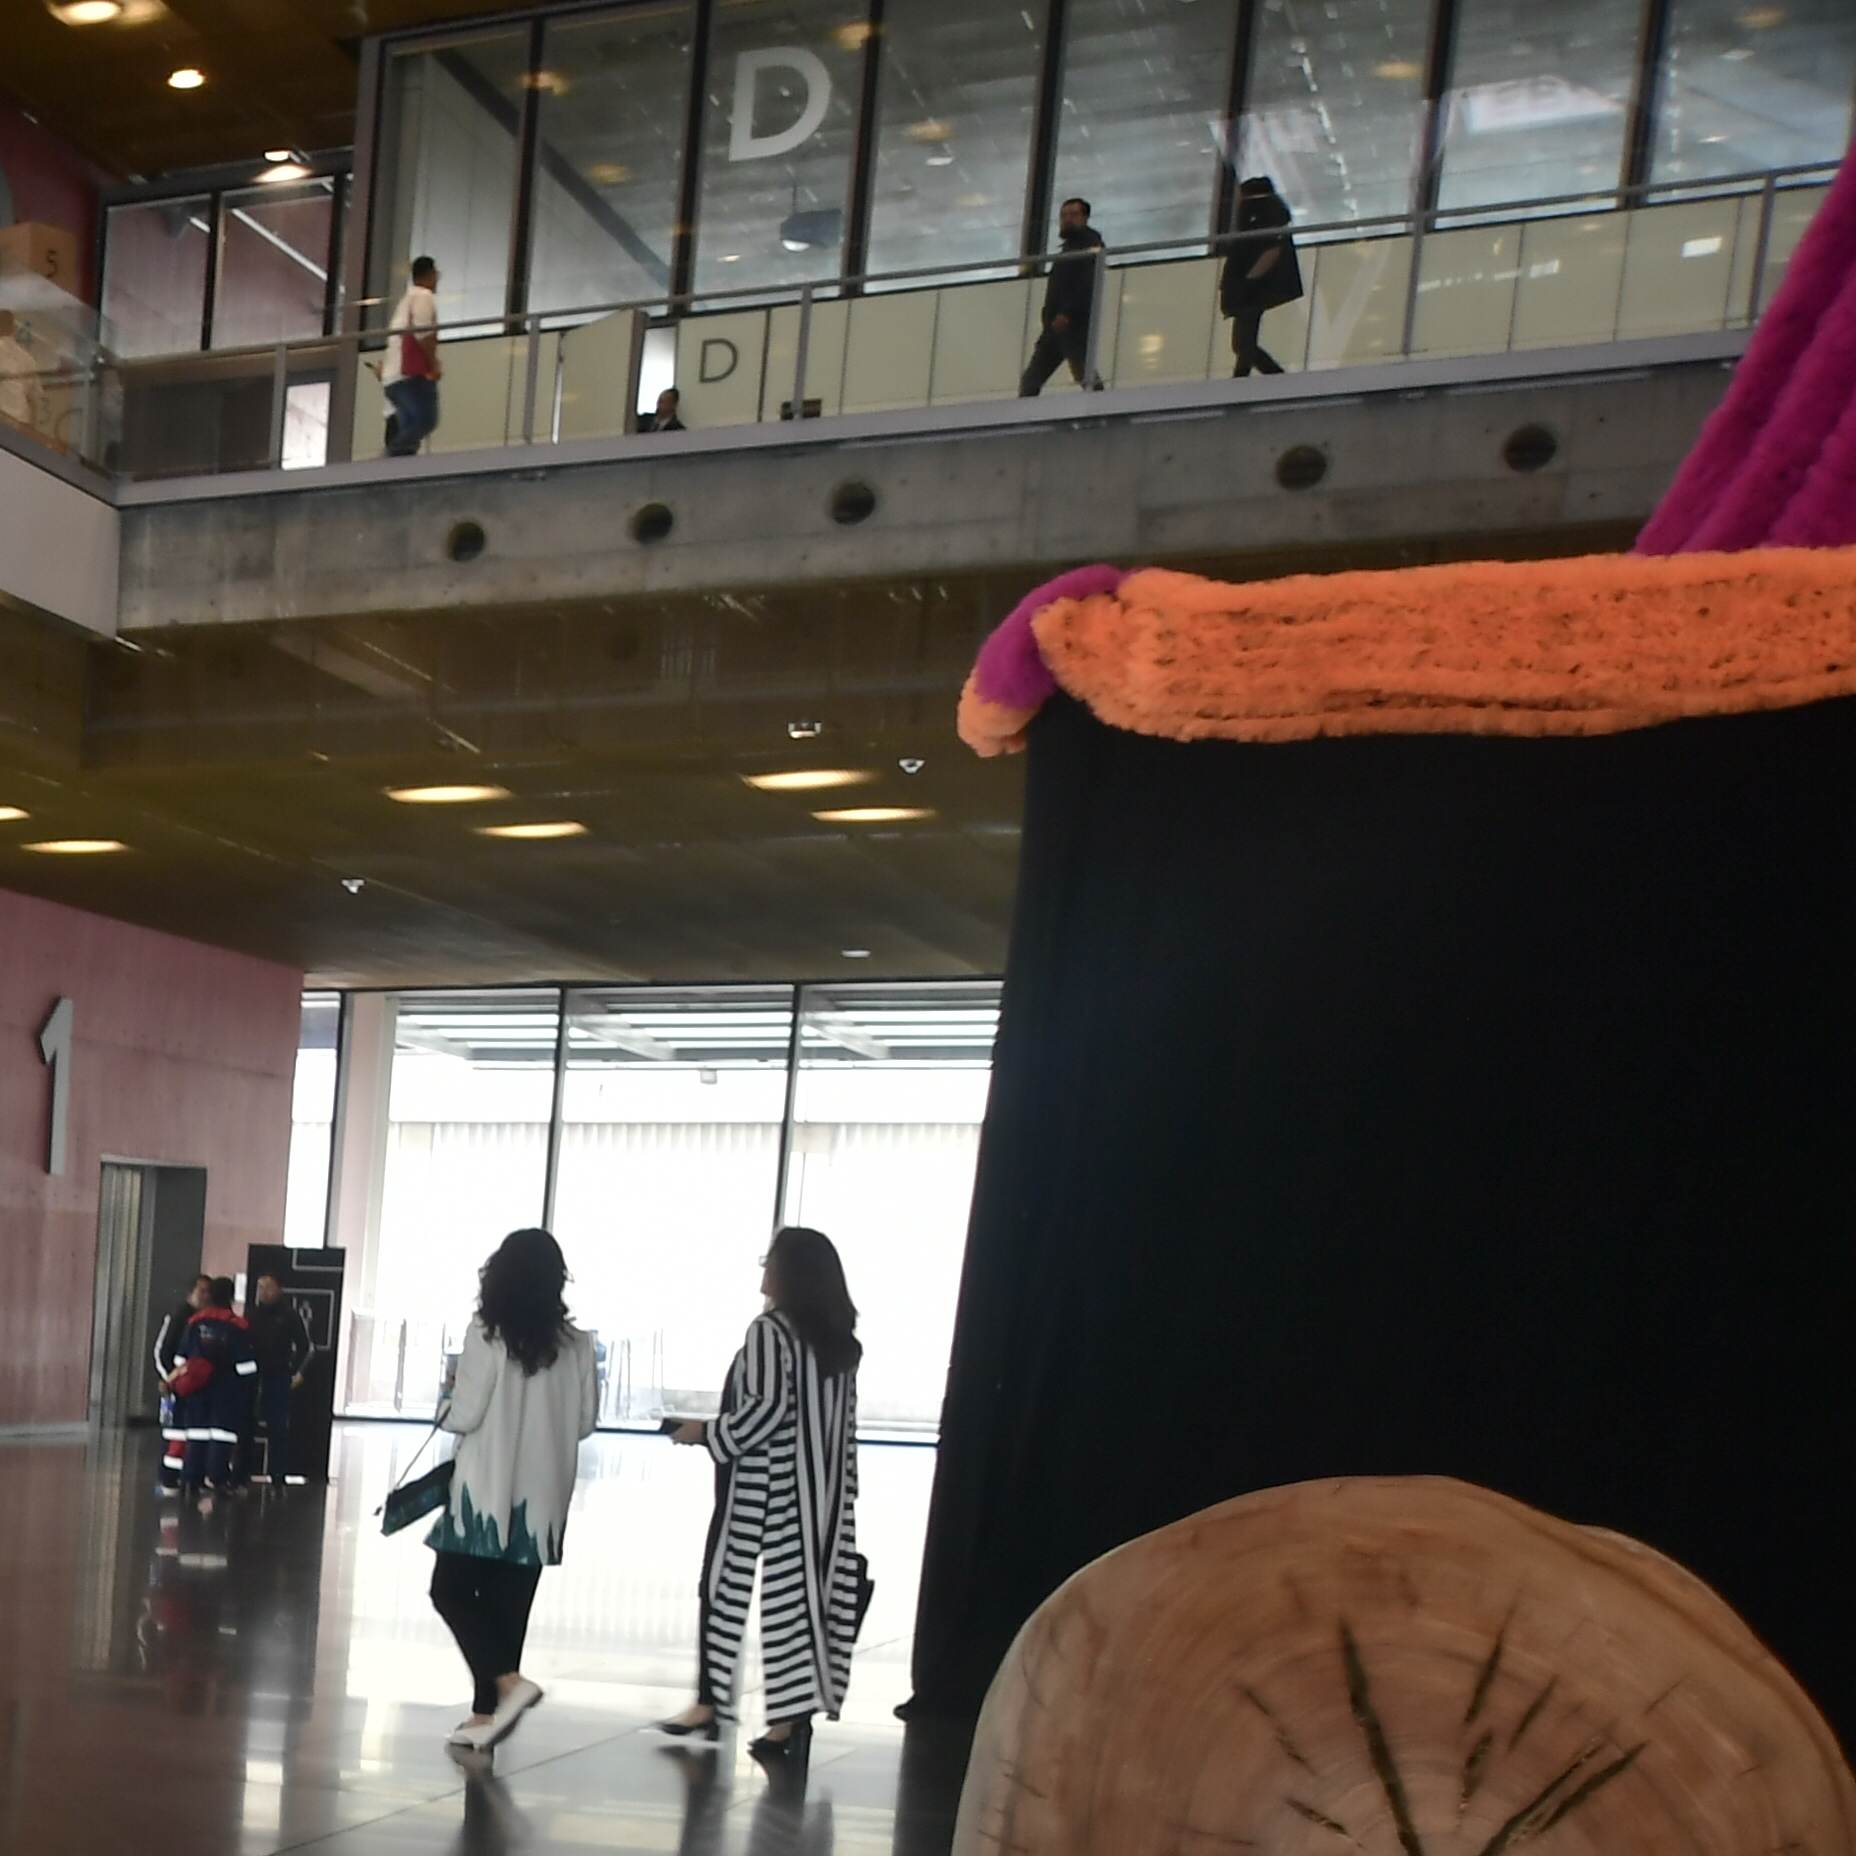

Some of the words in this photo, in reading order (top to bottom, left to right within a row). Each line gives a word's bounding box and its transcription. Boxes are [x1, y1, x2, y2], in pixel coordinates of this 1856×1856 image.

[728, 46, 832, 162] D
[46, 250, 58, 279] 5
[699, 338, 738, 383] D
[36, 996, 73, 1174] 1
